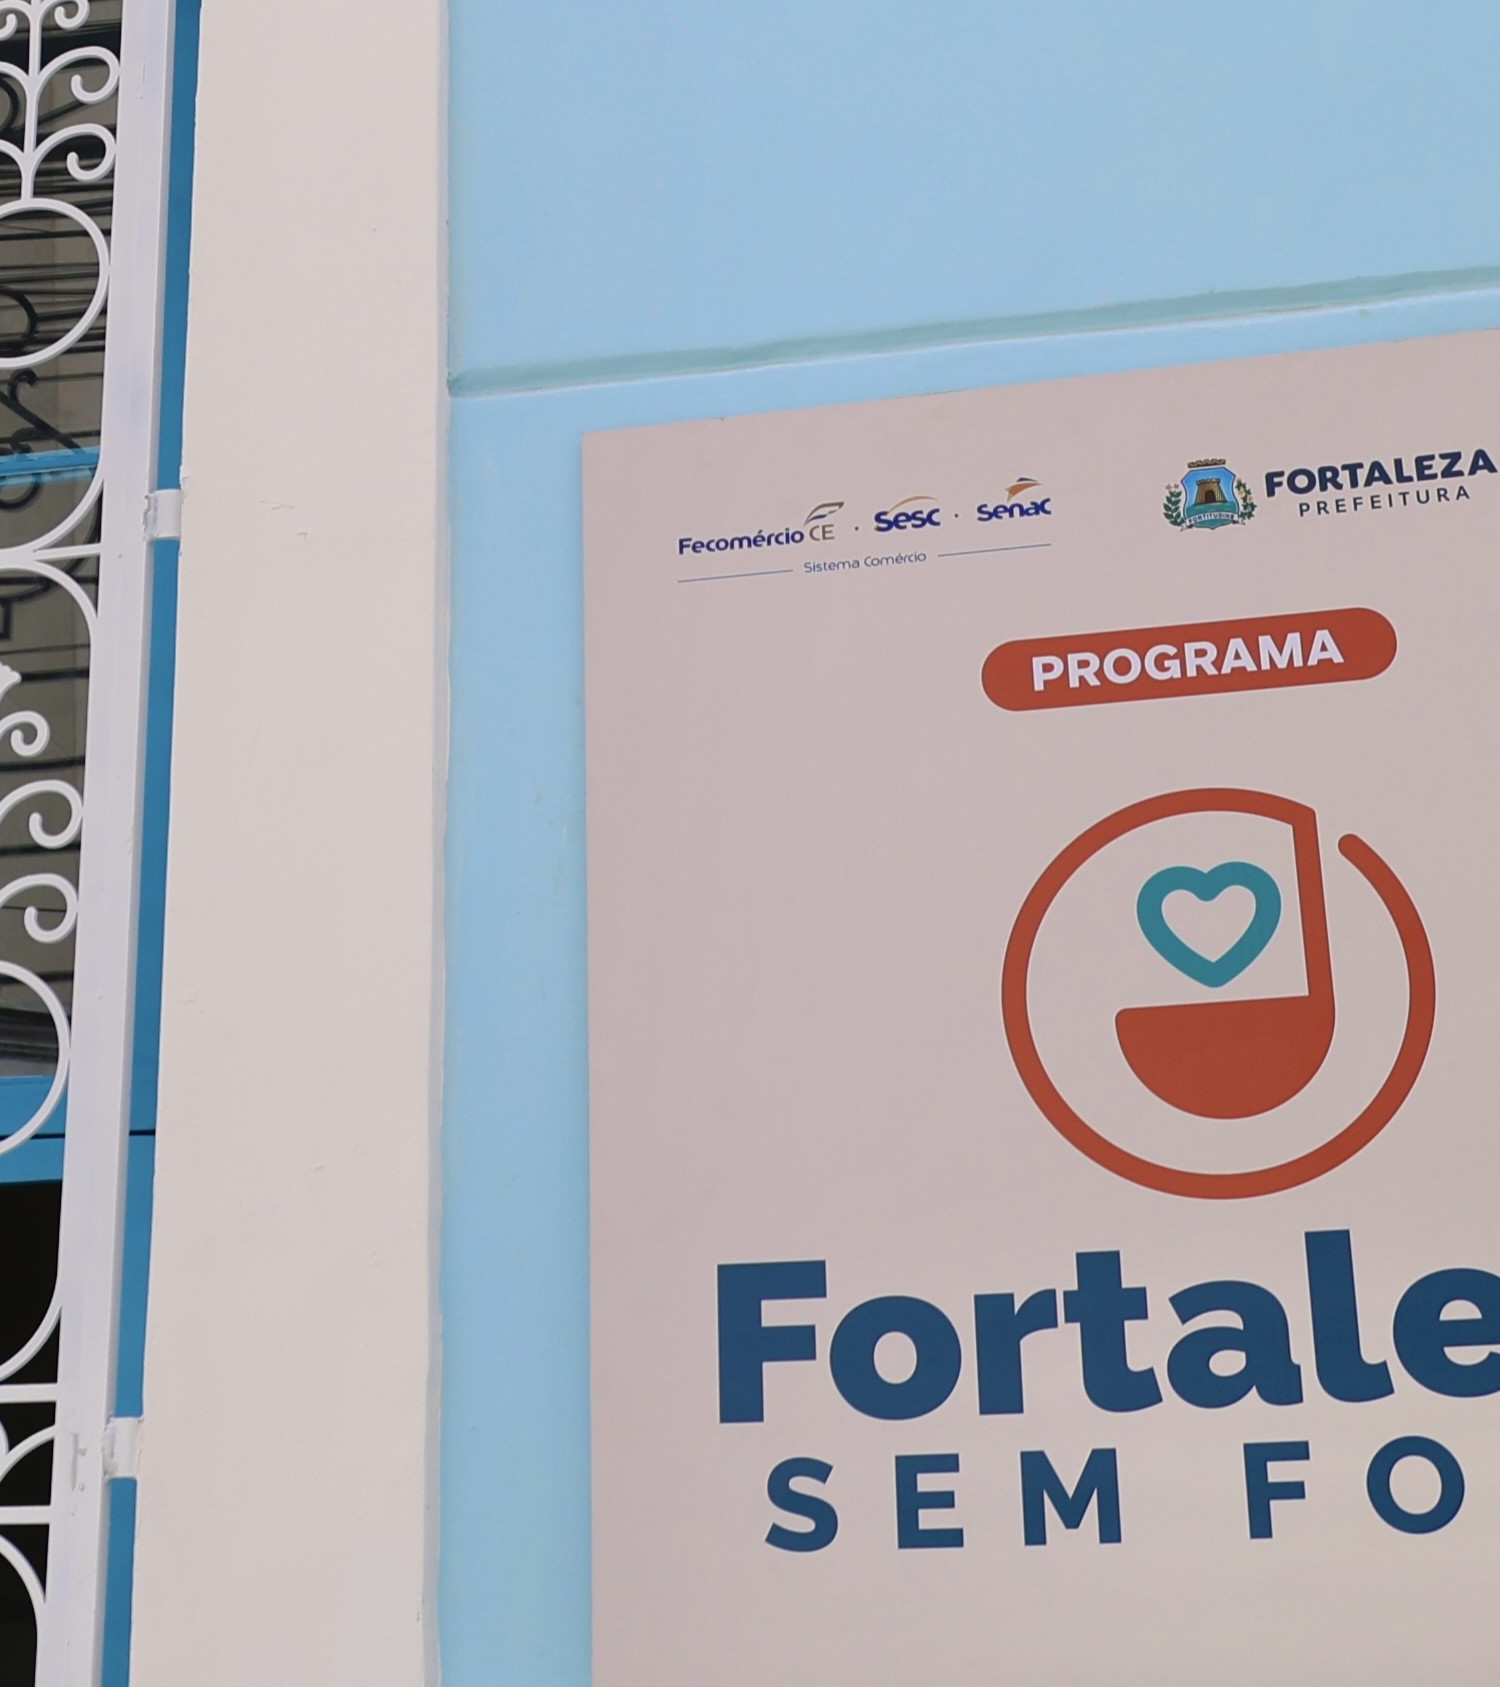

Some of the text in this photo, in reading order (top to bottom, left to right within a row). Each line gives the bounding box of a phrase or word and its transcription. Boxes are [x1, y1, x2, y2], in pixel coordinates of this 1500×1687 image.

[1264, 448, 1499, 498] FORTALEZA
[1297, 484, 1471, 517] PREFEITURA
[677, 526, 805, 556] Fecomércio
[808, 523, 836, 542] CE
[803, 550, 928, 574] Sistema Comércio
[1031, 628, 1345, 692] PROGRAMA
[764, 1447, 1123, 1554] SEM
